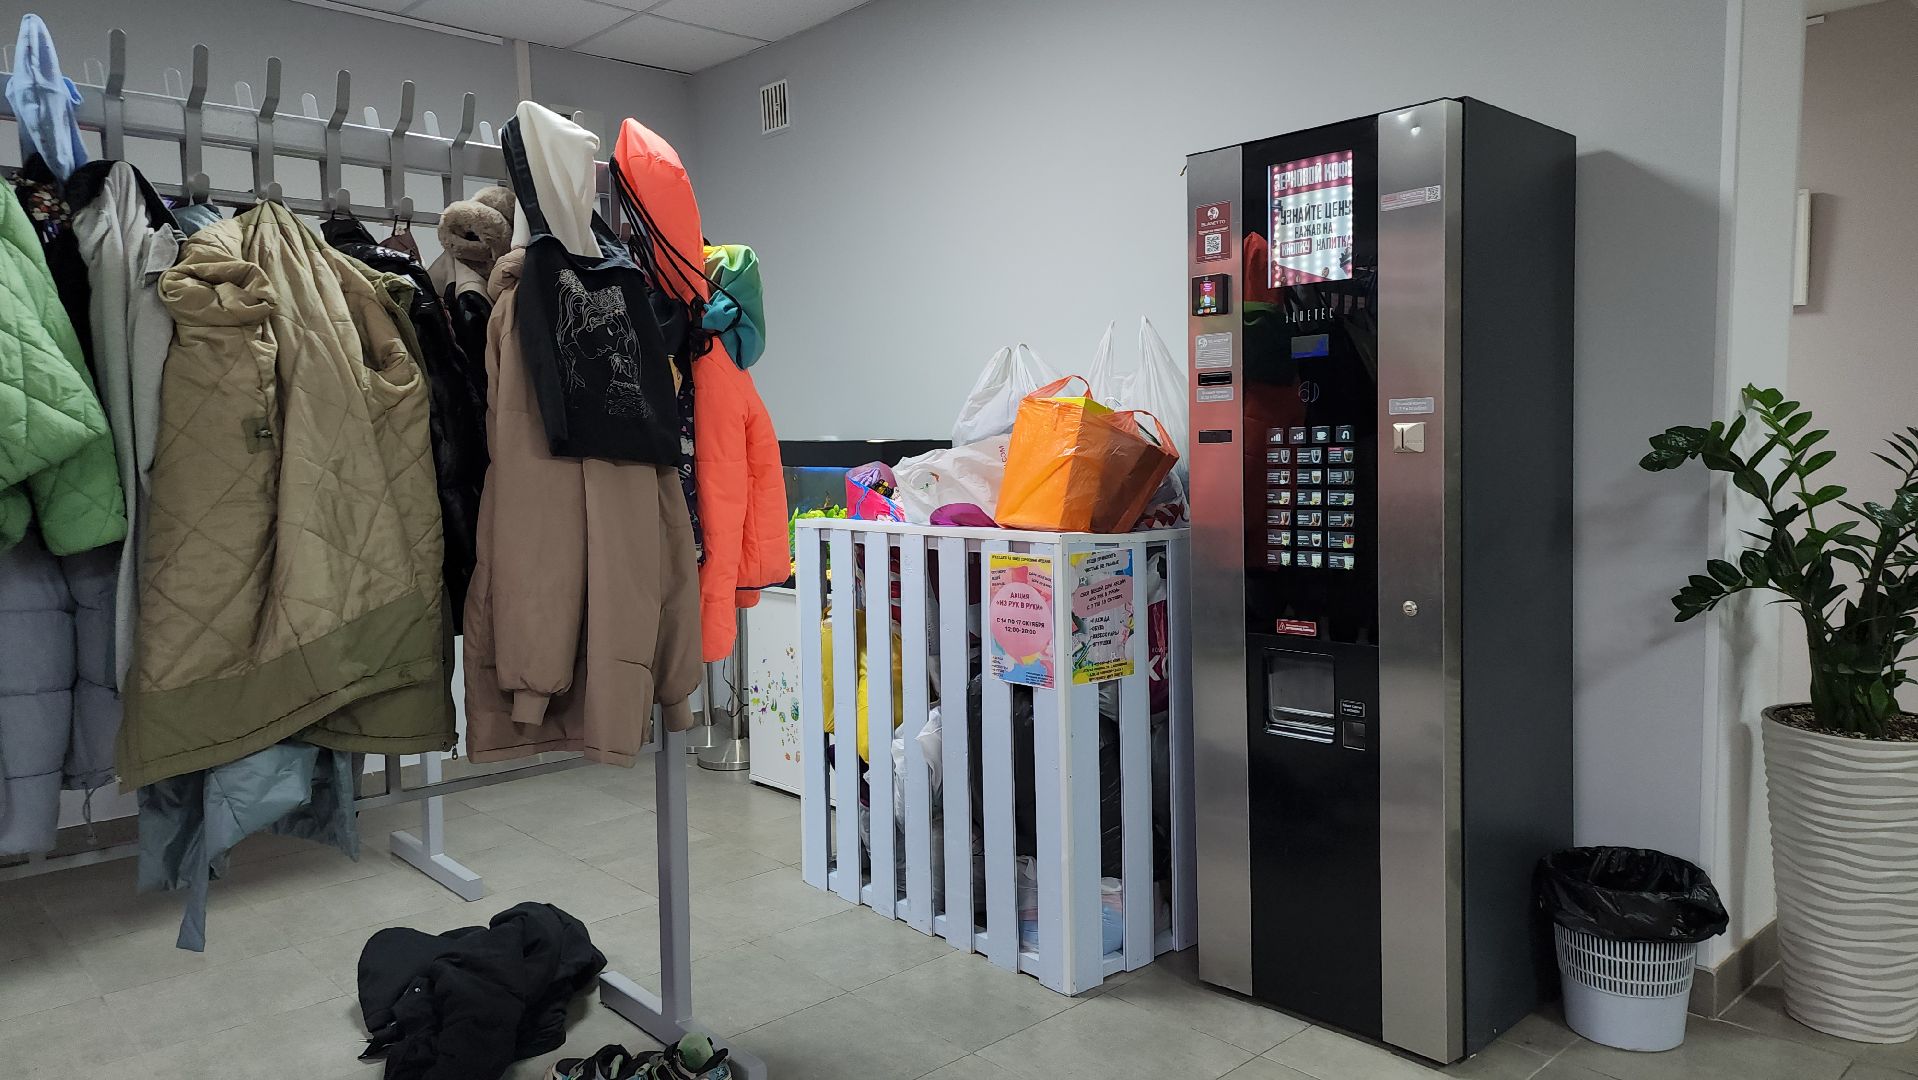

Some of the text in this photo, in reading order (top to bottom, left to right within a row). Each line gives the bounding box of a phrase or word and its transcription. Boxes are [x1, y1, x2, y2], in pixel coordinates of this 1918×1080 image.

[1274, 162, 1322, 191] ЗЕРНОВОЙ
[1281, 199, 1352, 226] УЗНАЙТЕ ЦЕНУ
[1323, 221, 1334, 235] НА
[1010, 592, 1030, 600] АКЦИЯ
[1022, 620, 1045, 628] ОКТЯБРЯ
